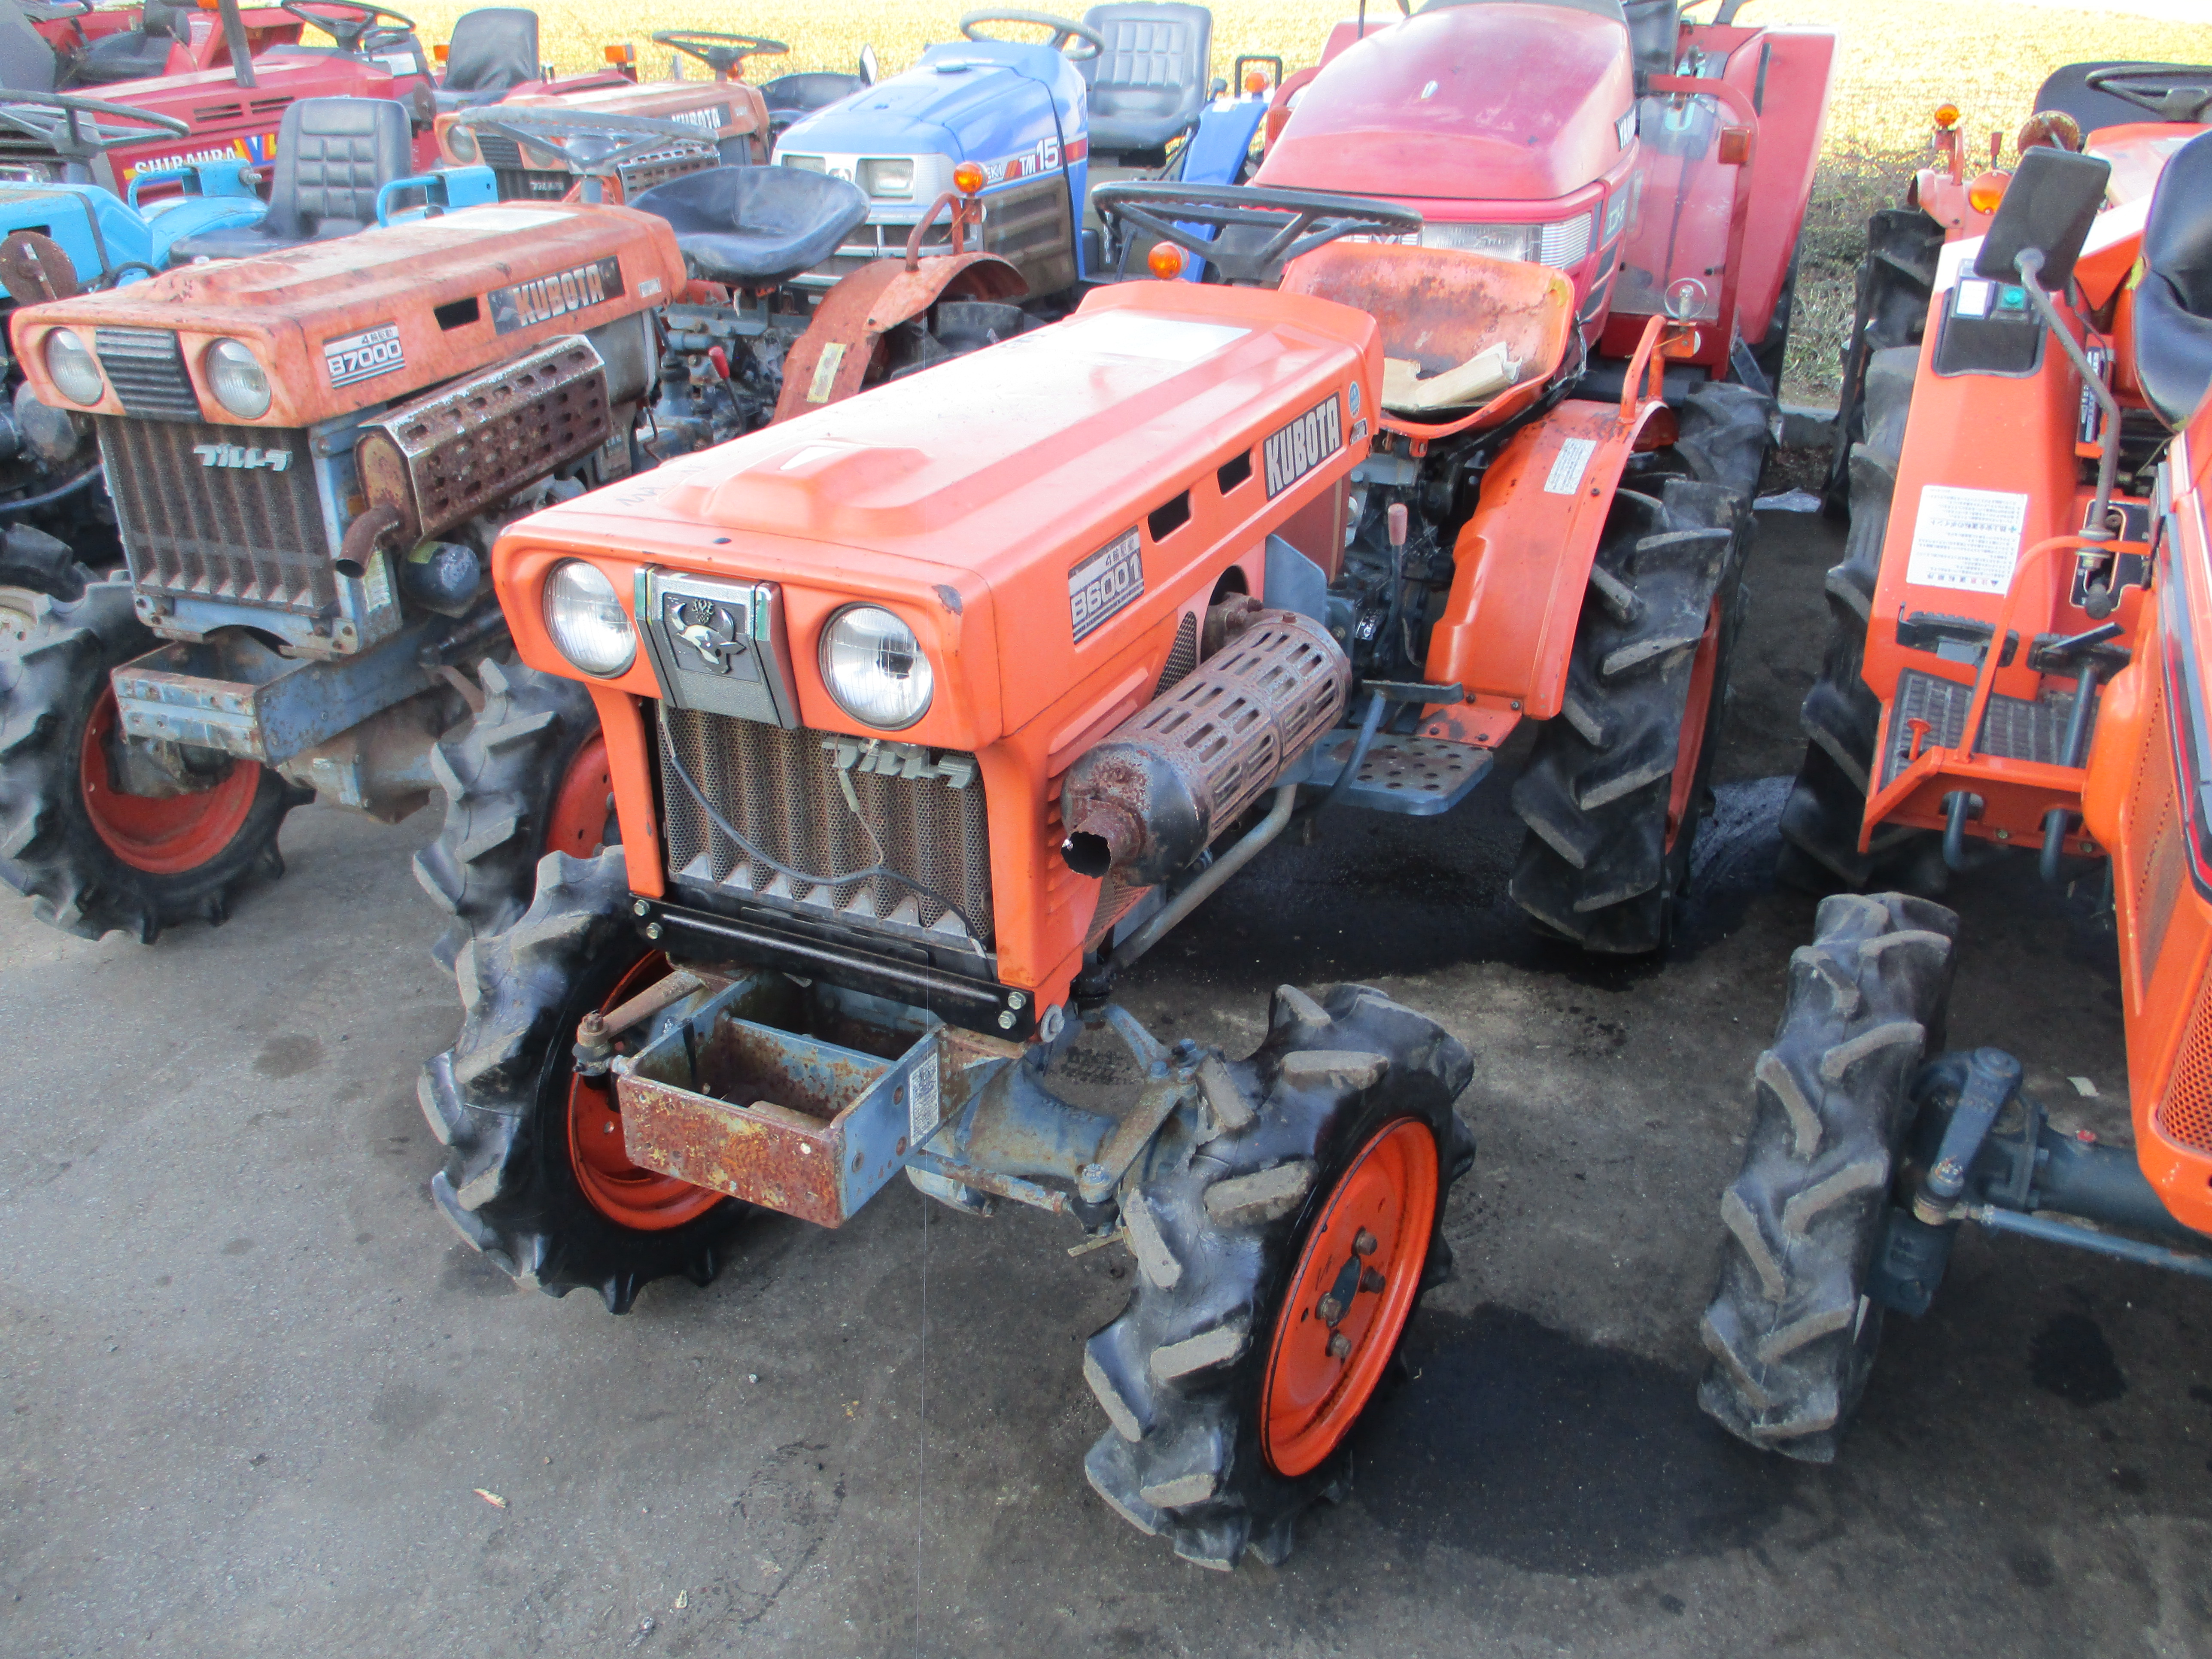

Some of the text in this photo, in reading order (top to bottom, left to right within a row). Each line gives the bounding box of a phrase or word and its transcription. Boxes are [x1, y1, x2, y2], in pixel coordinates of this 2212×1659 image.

[512, 264, 605, 327] KUBOTA
[328, 340, 403, 377] B7000
[1266, 396, 1340, 497] KUBOTA
[1071, 553, 1139, 626] B6001
